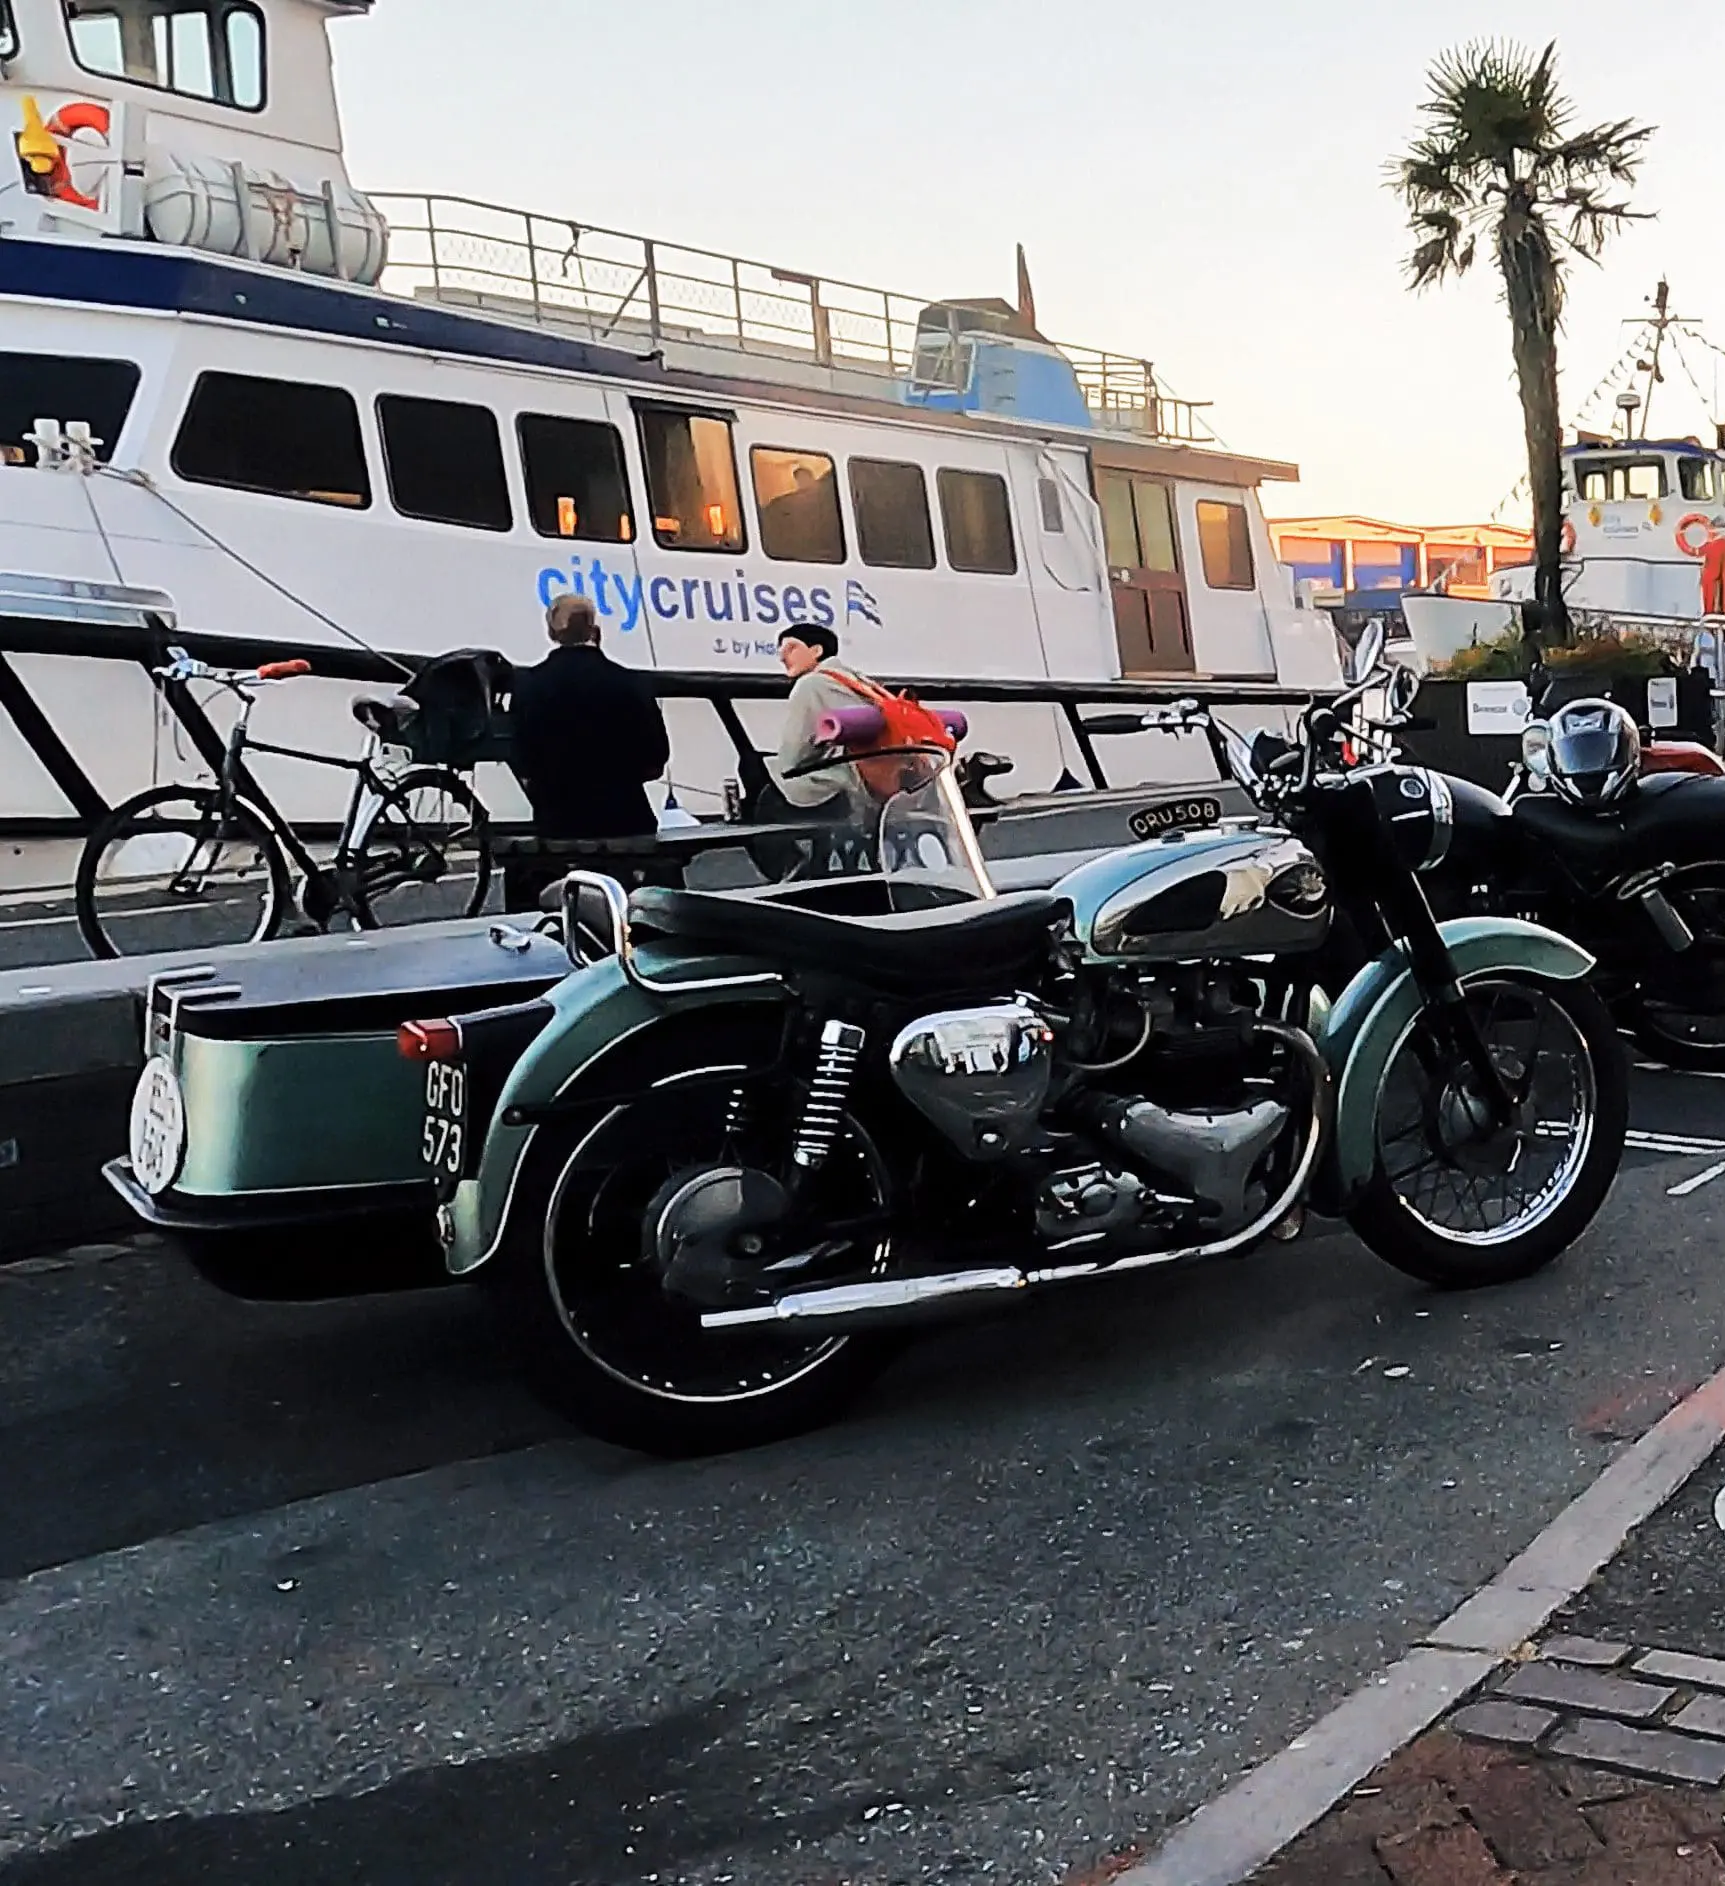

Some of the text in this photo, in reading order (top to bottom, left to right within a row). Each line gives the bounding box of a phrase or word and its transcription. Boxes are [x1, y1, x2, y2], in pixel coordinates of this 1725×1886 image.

[732, 640, 750, 658] by
[427, 1061, 463, 1116] GFO
[423, 1116, 461, 1173] 573
